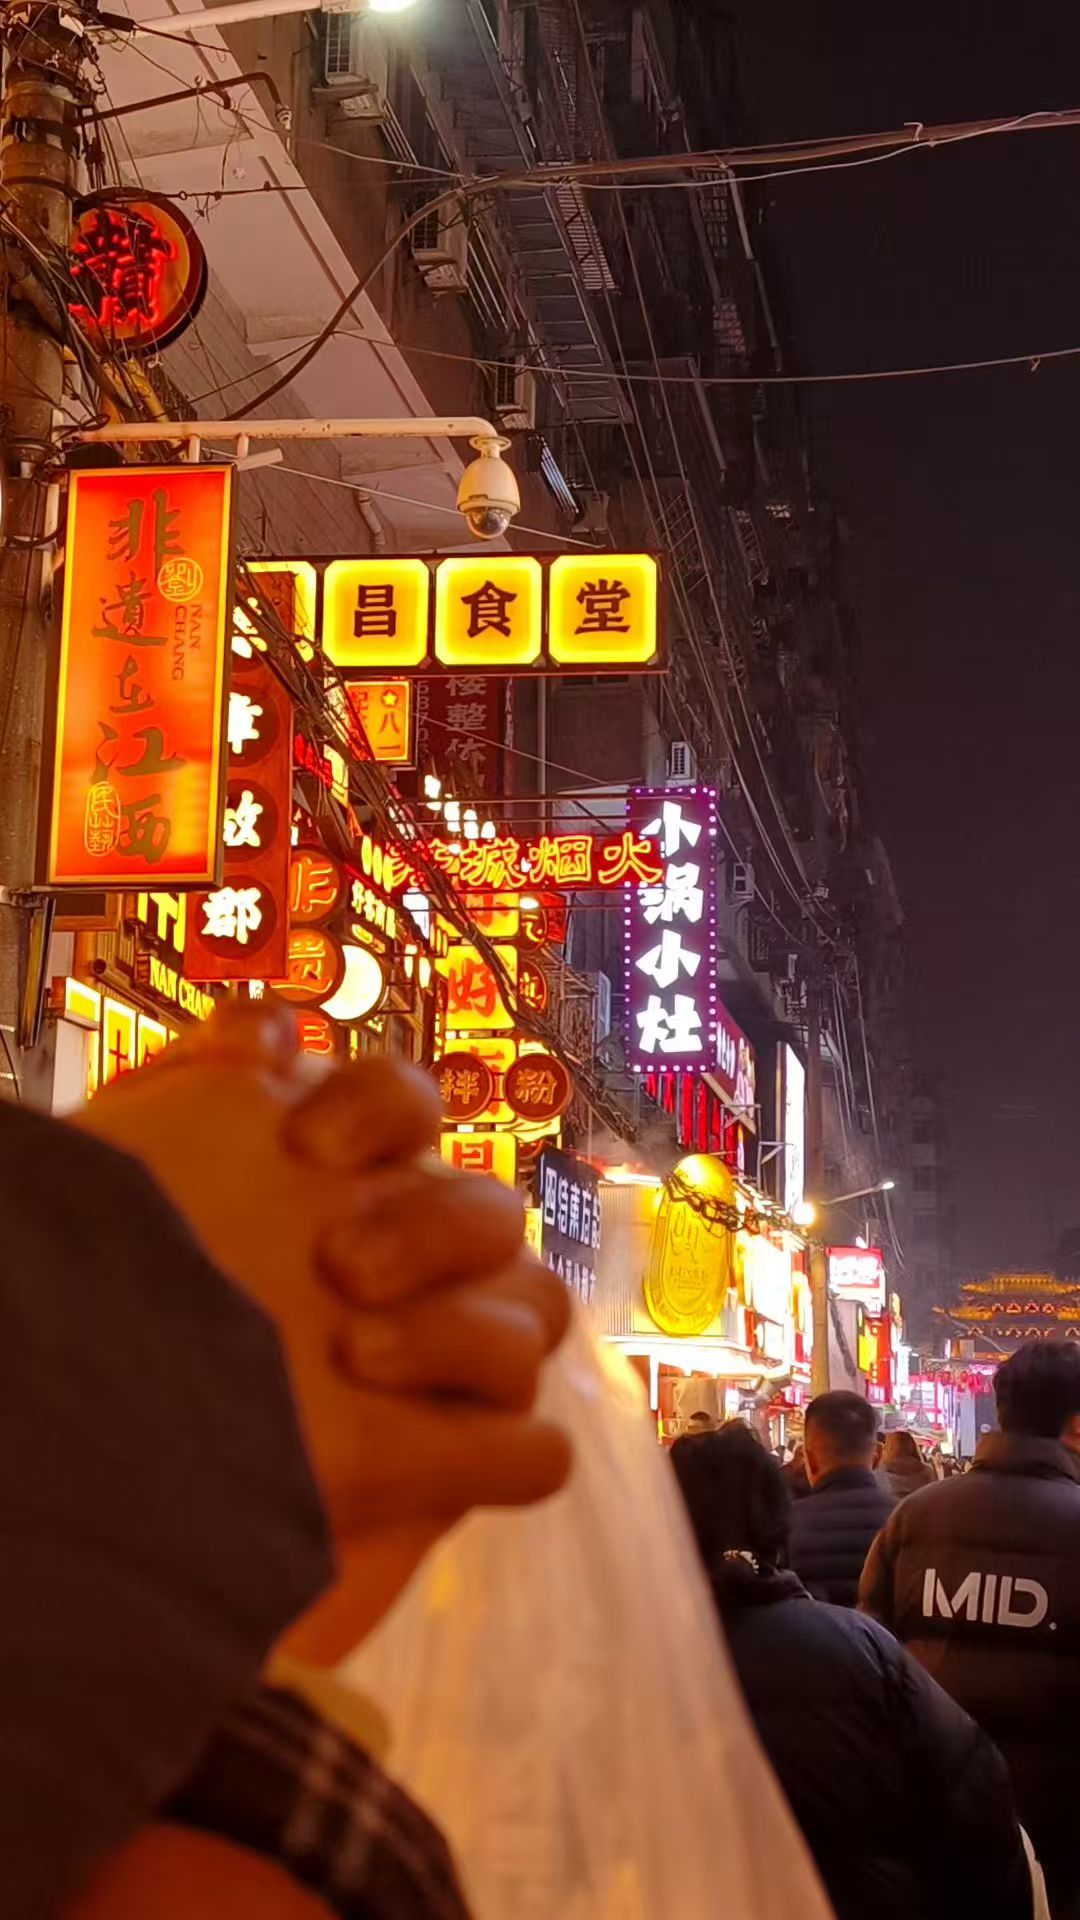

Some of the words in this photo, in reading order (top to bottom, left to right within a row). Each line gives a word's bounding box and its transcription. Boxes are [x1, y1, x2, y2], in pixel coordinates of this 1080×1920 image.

[171, 604, 188, 681] CHANG
[189, 603, 203, 650] NAN
[636, 801, 704, 1054] 小锅小灶
[150, 955, 178, 1001] NAN
[178, 977, 216, 1020] CHAN
